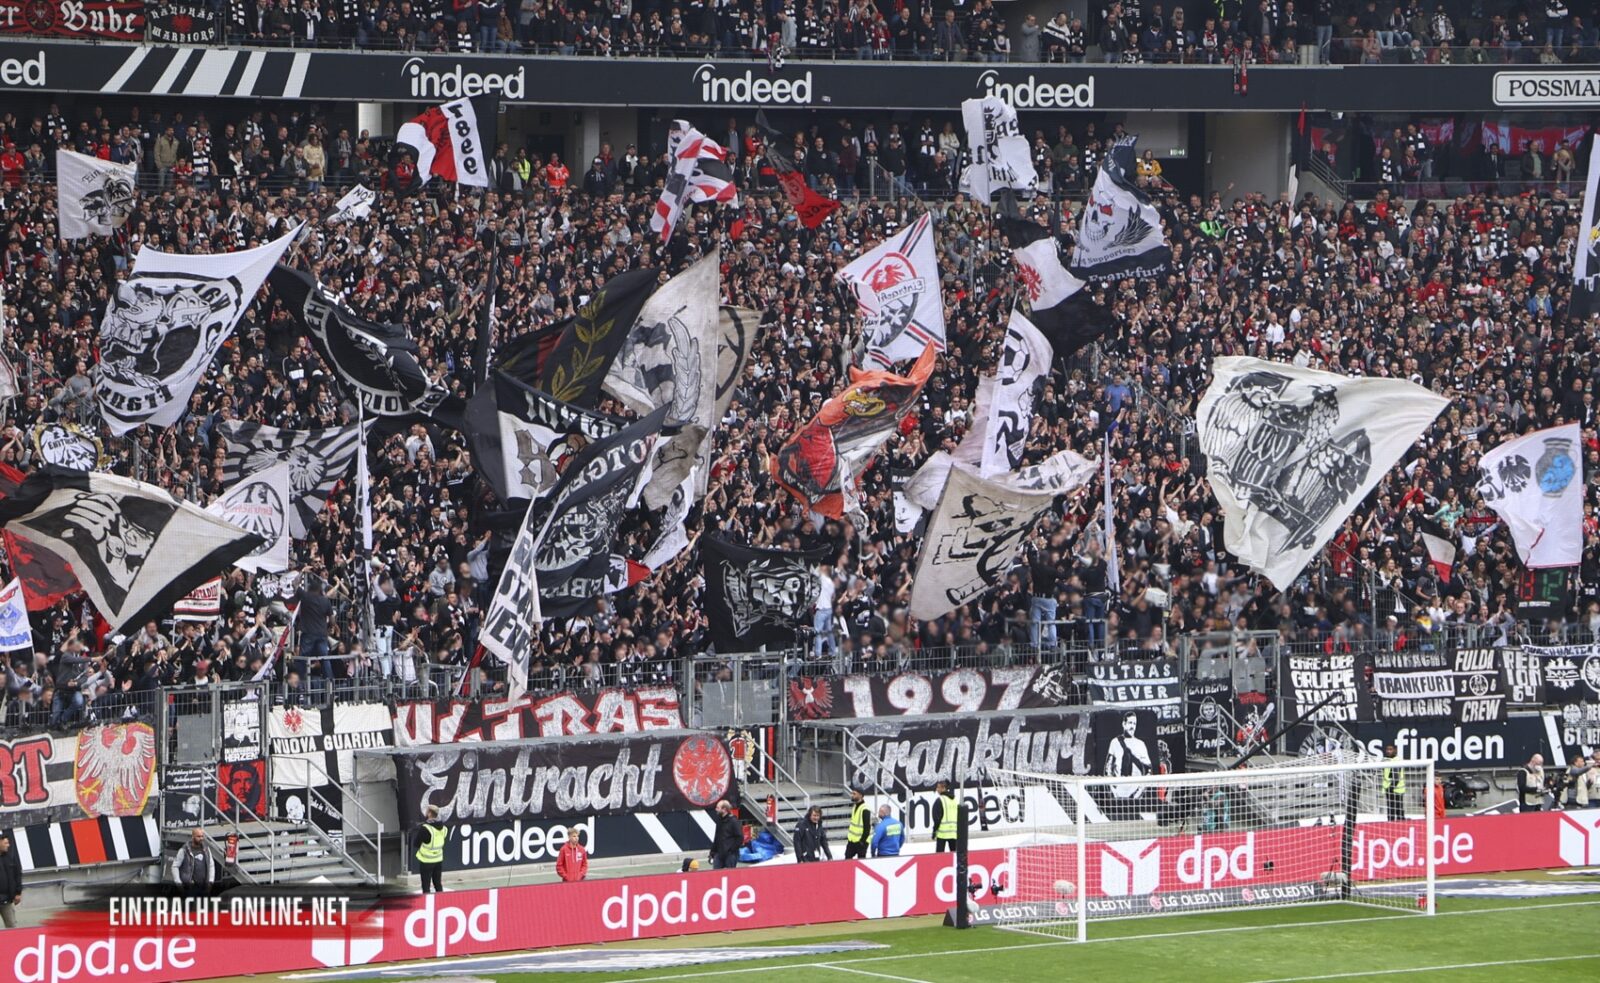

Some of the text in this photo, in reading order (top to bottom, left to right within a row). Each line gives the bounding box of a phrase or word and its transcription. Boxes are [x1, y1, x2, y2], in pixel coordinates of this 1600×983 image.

[60, 1, 137, 33] Bube
[409, 63, 525, 99] indeed
[701, 69, 812, 104] indeed
[985, 75, 1095, 108] indeed
[1509, 80, 1600, 97] POSSMA
[1088, 262, 1166, 283] Frankfurt
[1094, 664, 1171, 679] ULTRAS
[1455, 649, 1495, 672] FULDA
[1291, 669, 1355, 689] GRUPPE
[1378, 675, 1453, 694] FRANKFURT
[1461, 680, 1467, 693] 3
[843, 665, 1040, 718] 1997
[1103, 685, 1169, 701] NEVER
[1513, 686, 1537, 702] 64
[392, 688, 686, 747] ULTRAS
[1382, 698, 1452, 717] HOOLIGANS
[1462, 699, 1500, 722] CREW
[273, 732, 386, 754] NUOVA GUARDIA
[847, 711, 1093, 791] Frankfurt
[1394, 727, 1504, 761] finden
[415, 743, 663, 822] Eintracht
[460, 815, 595, 866] indeed
[1350, 825, 1474, 879] dpd.de
[1177, 831, 1255, 888] dpd
[1162, 892, 1224, 906] LG OLED TV
[1254, 884, 1315, 900] LG OLED TV
[602, 876, 756, 938] dpd.de
[973, 906, 1037, 921] LG OLED TV
[1087, 900, 1117, 912] OLED
[1116, 900, 1132, 910] TV
[404, 888, 498, 957] dpd
[14, 934, 197, 983] dpd.de
